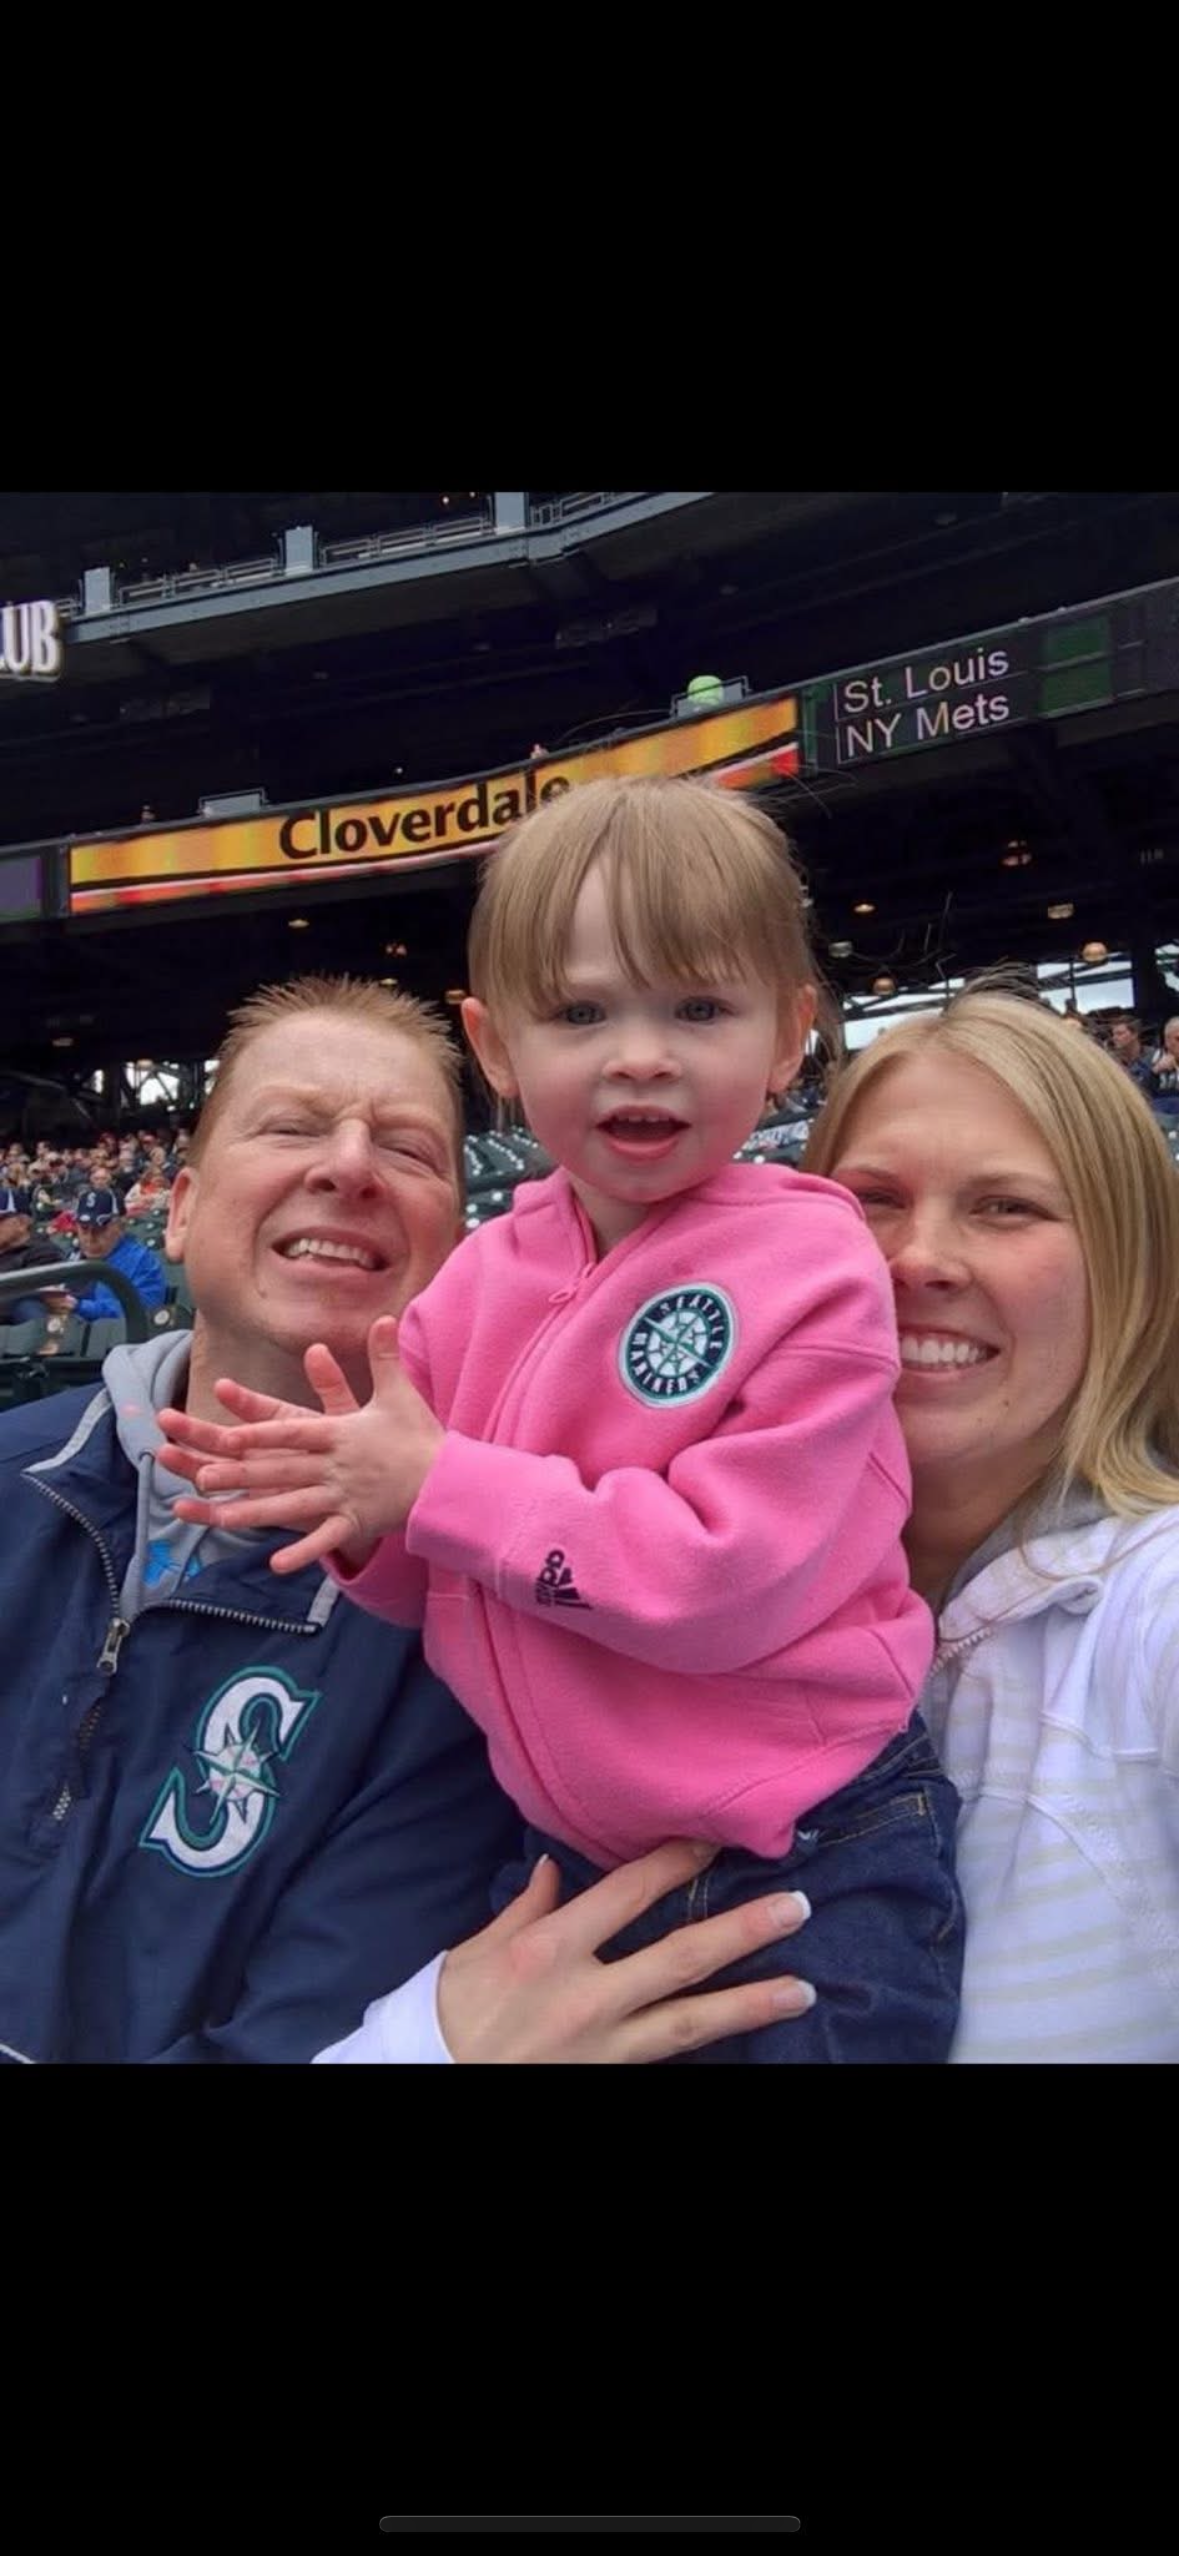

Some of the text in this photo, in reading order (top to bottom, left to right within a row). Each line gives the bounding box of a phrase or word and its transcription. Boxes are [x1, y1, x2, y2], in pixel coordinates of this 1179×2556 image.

[0, 600, 60, 673] UB
[844, 647, 1009, 713] St. Louis
[846, 693, 1010, 757] NY Mets
[279, 770, 570, 859] Cloverdale
[138, 1665, 320, 1878] S
